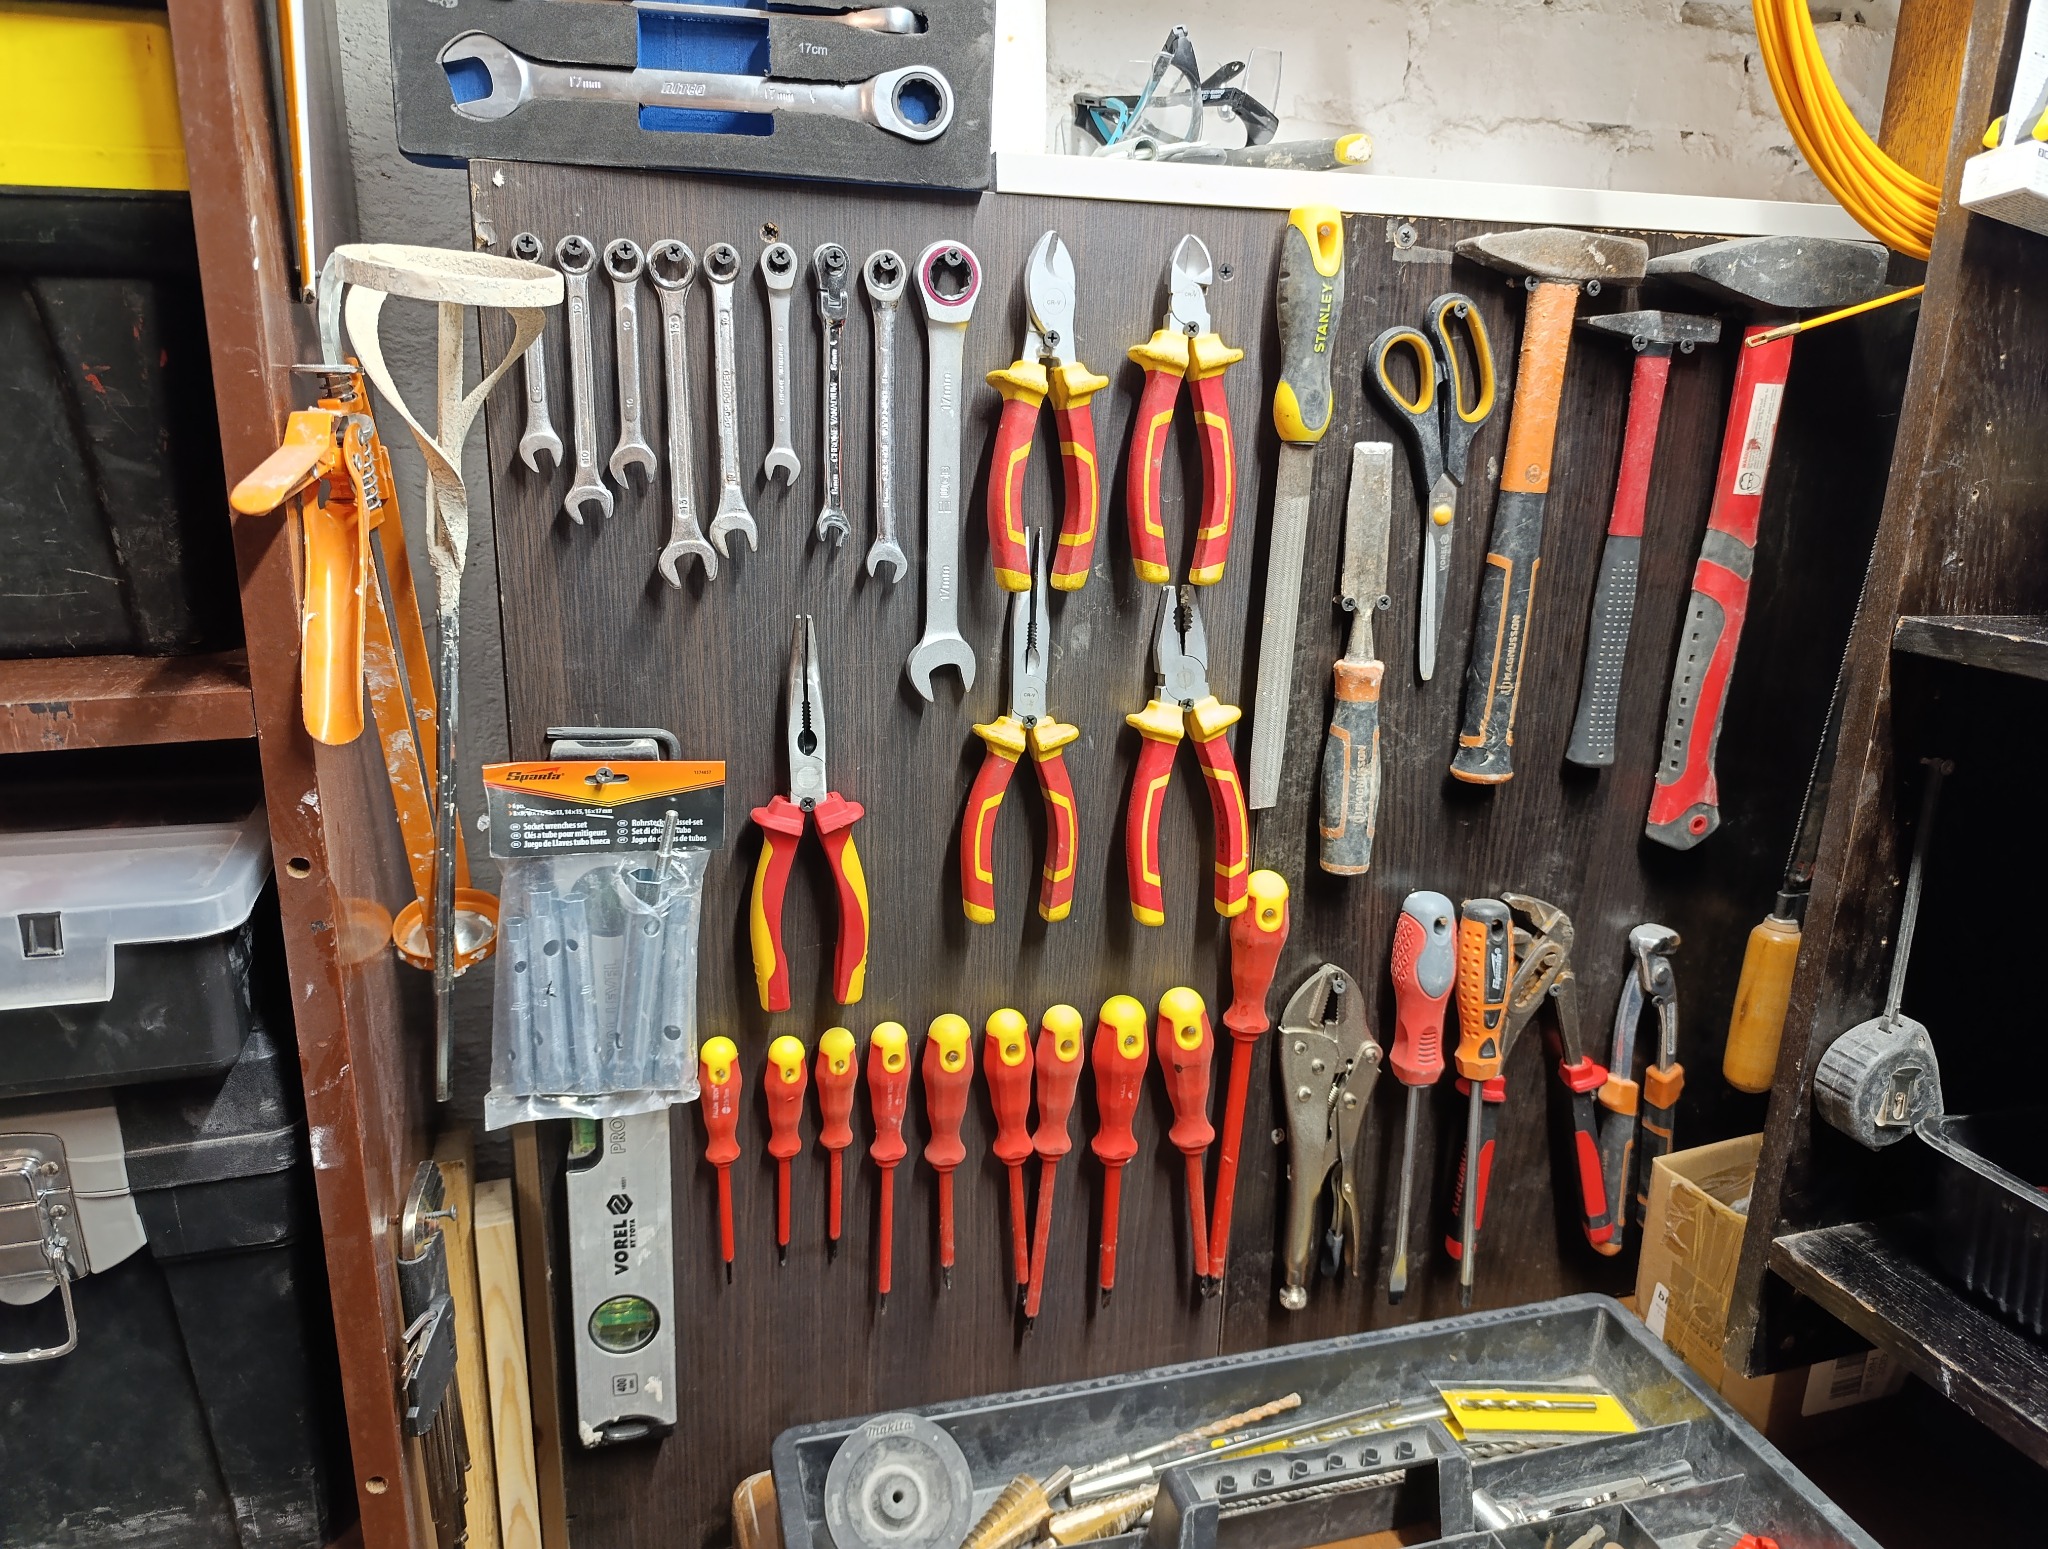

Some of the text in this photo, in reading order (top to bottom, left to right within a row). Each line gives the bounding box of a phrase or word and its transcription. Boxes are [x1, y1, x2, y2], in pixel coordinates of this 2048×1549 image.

[799, 42, 828, 56] 17cm
[1314, 281, 1333, 353] STANLEY
[622, 320, 632, 332] 10
[626, 397, 635, 408] 10
[829, 382, 839, 463] CHROME VANADIUM
[1503, 614, 1521, 681] MAGNUSSON
[506, 771, 561, 783] Sparta
[523, 821, 588, 831] Socket wrenches set
[631, 827, 643, 835] Set
[643, 827, 651, 835] di
[542, 831, 557, 839] tube
[558, 831, 574, 840] pour
[575, 829, 607, 839] mitigeurs
[631, 835, 648, 845] Jogo
[648, 835, 656, 843] de
[680, 835, 688, 843] de
[688, 834, 707, 842] tubos
[523, 837, 611, 850] Juego de Llaves tubo hueca
[613, 1218, 630, 1276] VOREL
[616, 1377, 628, 1392] 400
